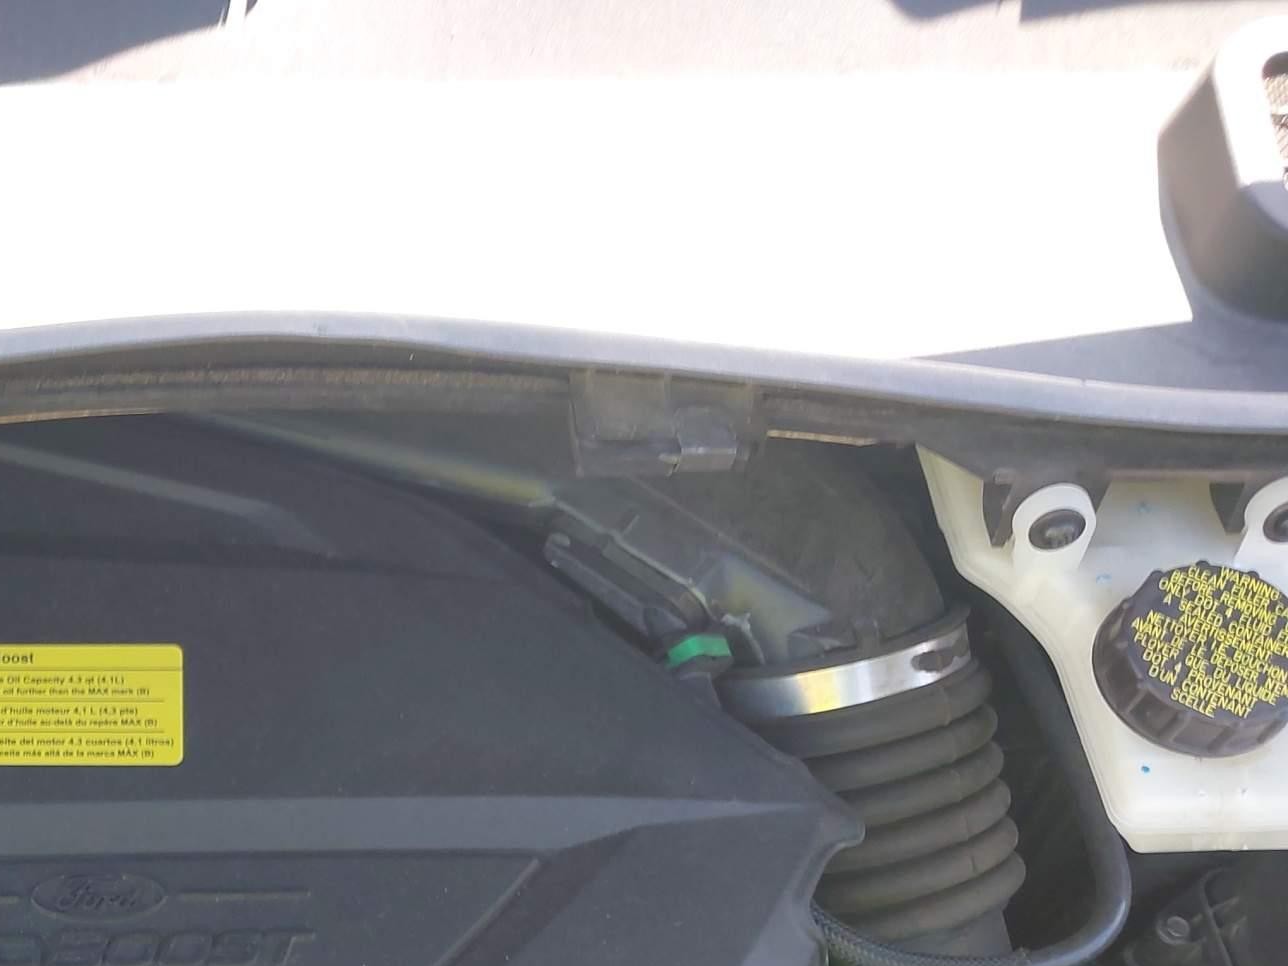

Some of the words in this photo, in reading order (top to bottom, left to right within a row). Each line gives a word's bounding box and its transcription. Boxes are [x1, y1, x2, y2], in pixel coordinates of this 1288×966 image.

[1172, 570, 1214, 597] BEFORE
[1188, 566, 1227, 590] CLEAN
[1231, 584, 1270, 610] FILLER
[1159, 577, 1191, 598] ONLY
[1195, 595, 1220, 612] DOT
[1225, 608, 1232, 619] 4
[1239, 613, 1272, 635] FLUID
[1163, 592, 1172, 606] A
[1179, 599, 1223, 627] SEALED
[1131, 617, 1166, 639] AVANT
[1171, 636, 1187, 650] DE
[1191, 644, 1208, 659] LE
[1134, 632, 1179, 660] PLOYER
[1185, 655, 1209, 674] QUE
[1213, 668, 1232, 683] DU
[17, 687, 46, 695] further
[23, 675, 65, 685] Capacity
[1143, 649, 1168, 667] DOT
[1174, 662, 1182, 674] 4
[1188, 669, 1258, 708] PROVENANT
[36, 706, 70, 714] moteur
[1182, 680, 1252, 719] CONTENANT
[37, 738, 66, 746] motor
